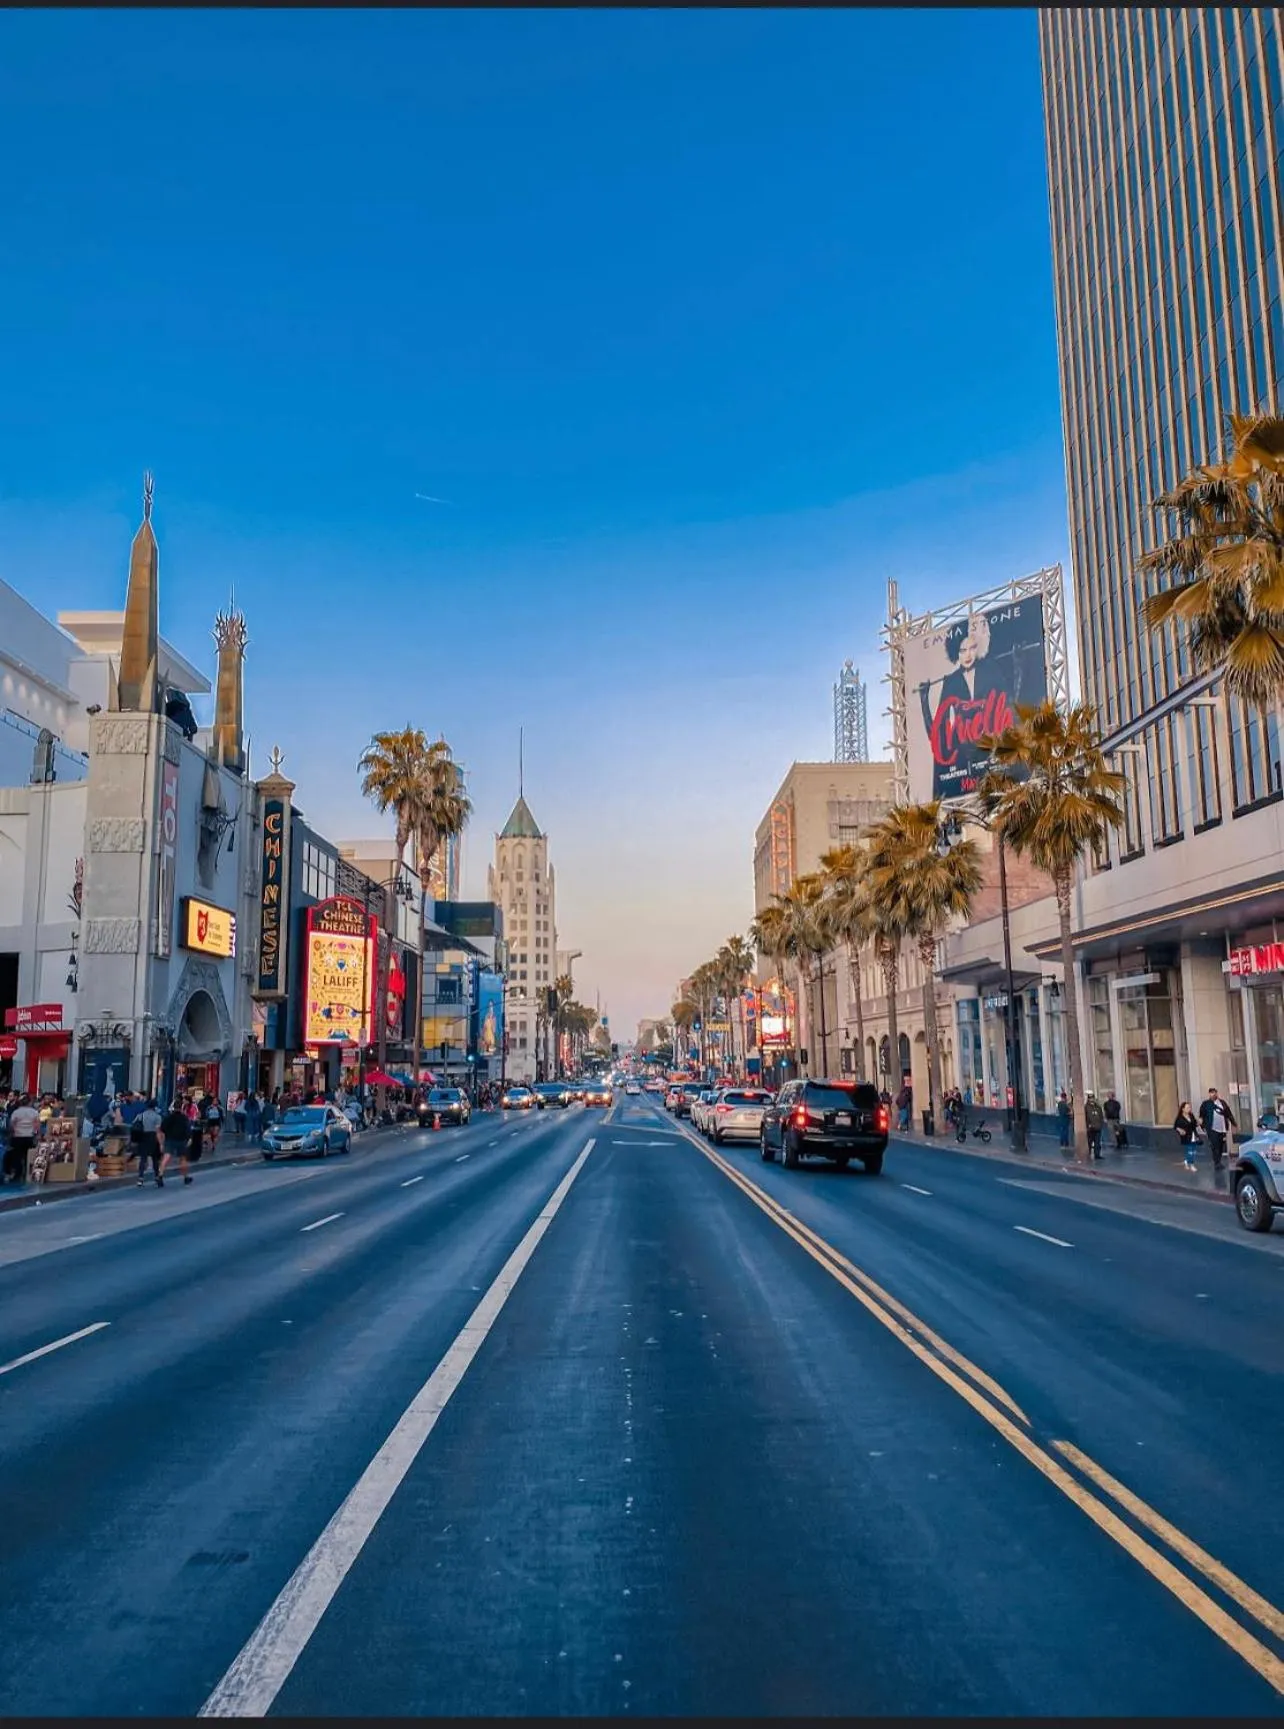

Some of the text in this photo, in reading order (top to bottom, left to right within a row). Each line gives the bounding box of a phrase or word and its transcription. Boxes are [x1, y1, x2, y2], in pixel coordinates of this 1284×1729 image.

[923, 606, 1021, 649] EMMA STONE
[163, 776, 177, 871] TCL
[261, 813, 281, 976] CHINESE
[336, 900, 352, 912] TCL
[323, 909, 363, 924] CHINESE
[323, 974, 358, 988] LALIFF
